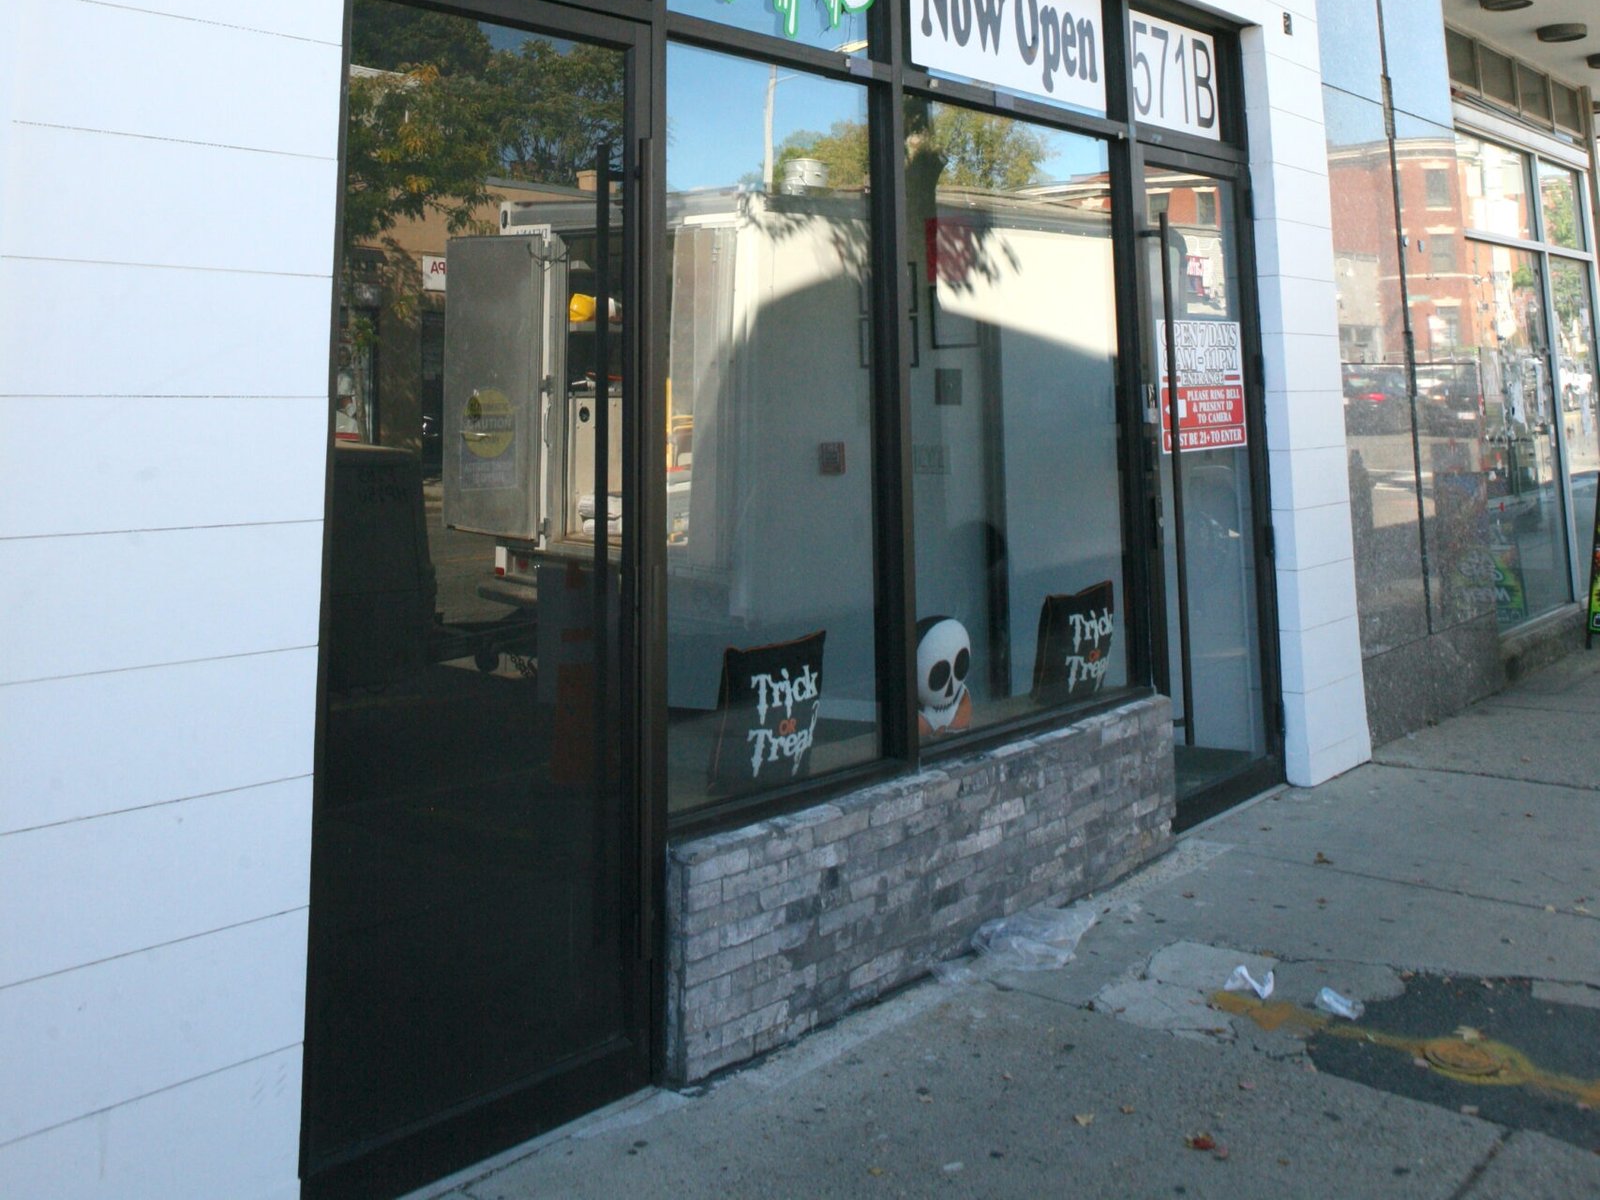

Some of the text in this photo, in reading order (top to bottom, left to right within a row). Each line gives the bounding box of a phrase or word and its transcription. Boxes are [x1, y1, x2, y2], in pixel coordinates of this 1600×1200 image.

[1132, 20, 1215, 130] 571B
[1208, 323, 1238, 347] DAYS
[1182, 371, 1224, 386] ENTRANCE
[1187, 388, 1240, 402] PLEASE RING BELL
[1199, 401, 1225, 412] PRESENT
[1197, 412, 1232, 424] TO CAMERA
[1189, 432, 1198, 445] BE
[1211, 430, 1220, 443] TO
[1221, 429, 1242, 442] ENTER
[1069, 607, 1114, 654] Trick
[1065, 649, 1111, 694] Trea
[750, 664, 819, 726] Trick
